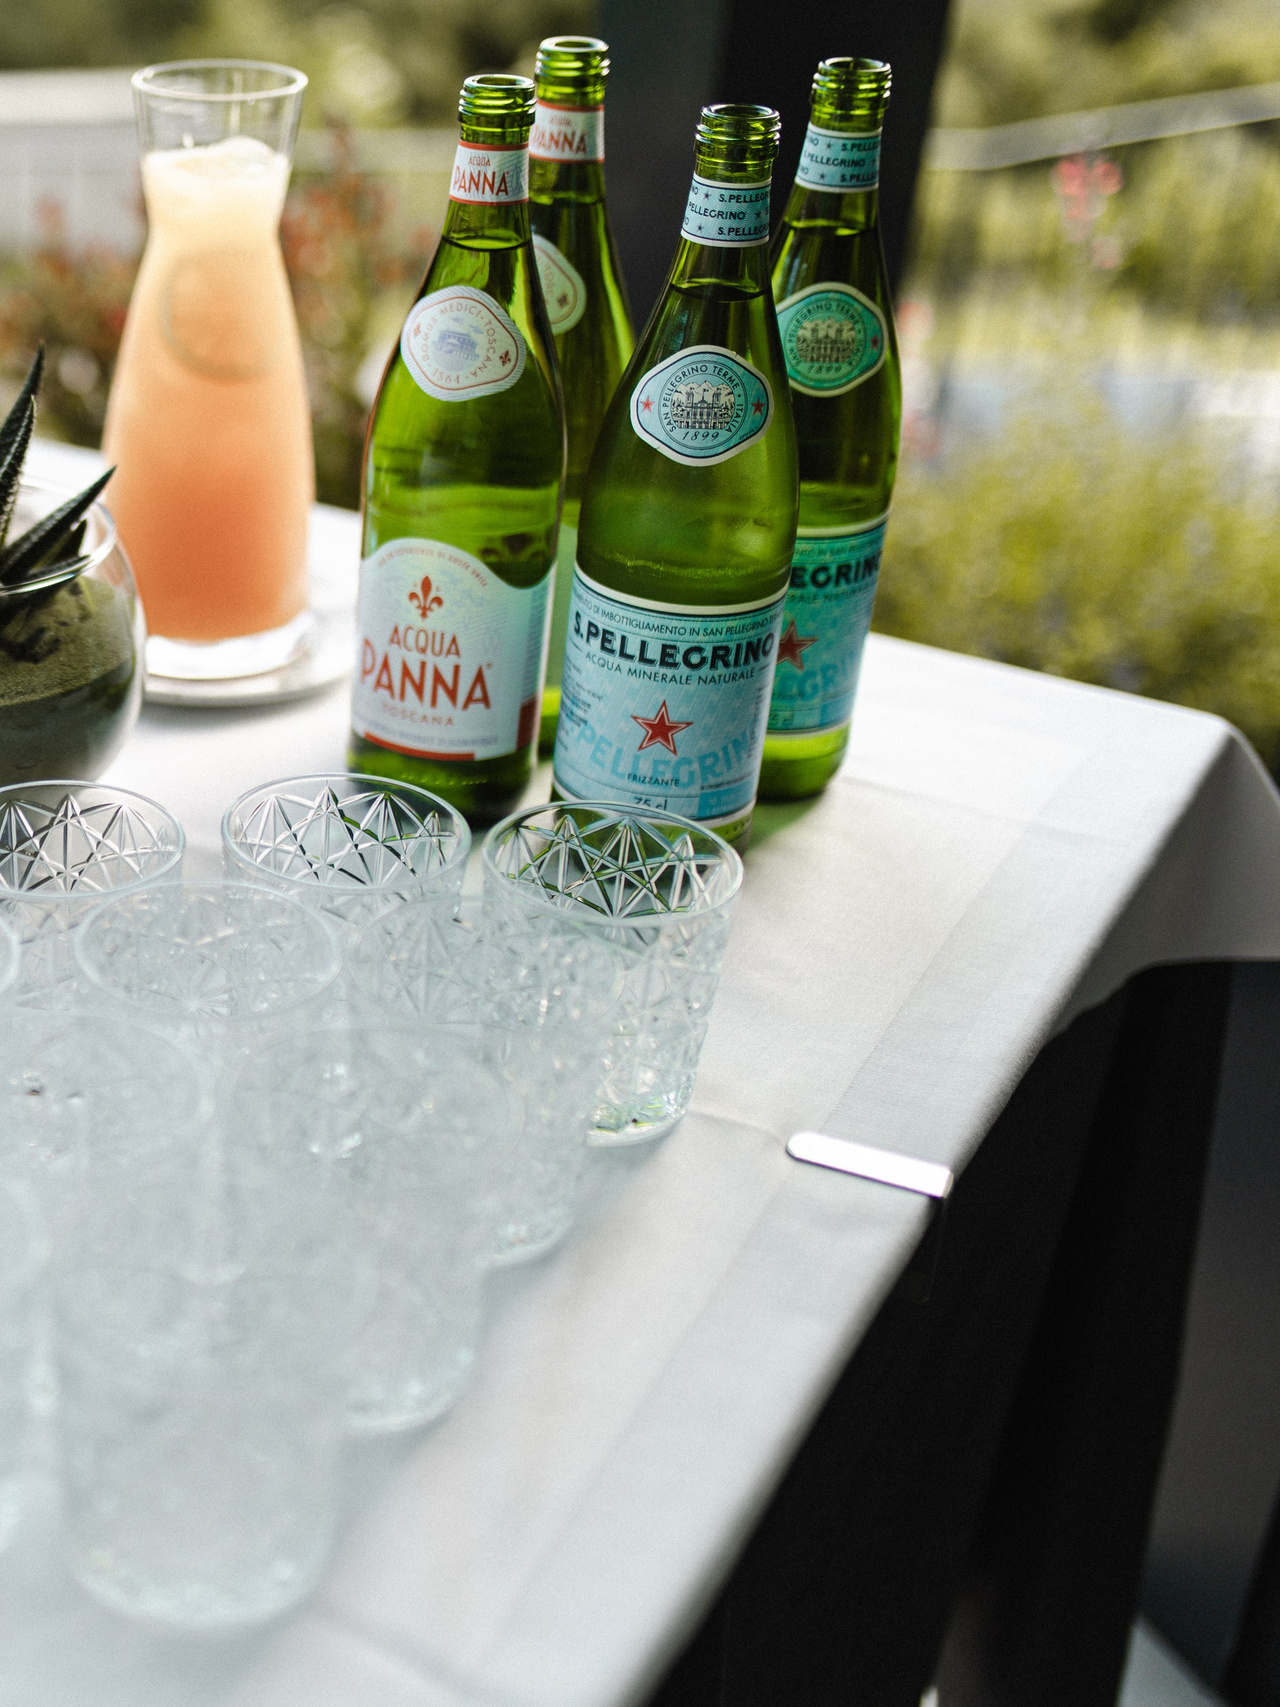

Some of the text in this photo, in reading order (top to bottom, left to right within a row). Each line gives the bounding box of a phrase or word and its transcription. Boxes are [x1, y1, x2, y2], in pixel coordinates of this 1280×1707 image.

[468, 155, 491, 168] ACQUA
[453, 164, 509, 197] PANNA
[440, 302, 482, 318] MEDICI
[470, 319, 497, 379] TOSCANA
[662, 364, 708, 408] PELLEGRINO
[713, 365, 740, 390] TERME
[662, 413, 677, 433] SAN
[724, 403, 744, 434] ITALIA
[682, 430, 720, 442] 1899
[600, 609, 687, 637] IMBOTTIGLIAMENTO
[688, 626, 701, 636] IN
[702, 626, 723, 637] SAN
[725, 617, 769, 635] PELLEGRINO
[389, 624, 461, 659] ACQUA
[573, 610, 775, 671] S.PELLEGRINO
[360, 637, 492, 712] PANNA
[585, 651, 755, 686] ACQUA MINERALE NATURALE
[381, 701, 455, 727] TOSCANA
[627, 773, 680, 787] FRIZZANTE
